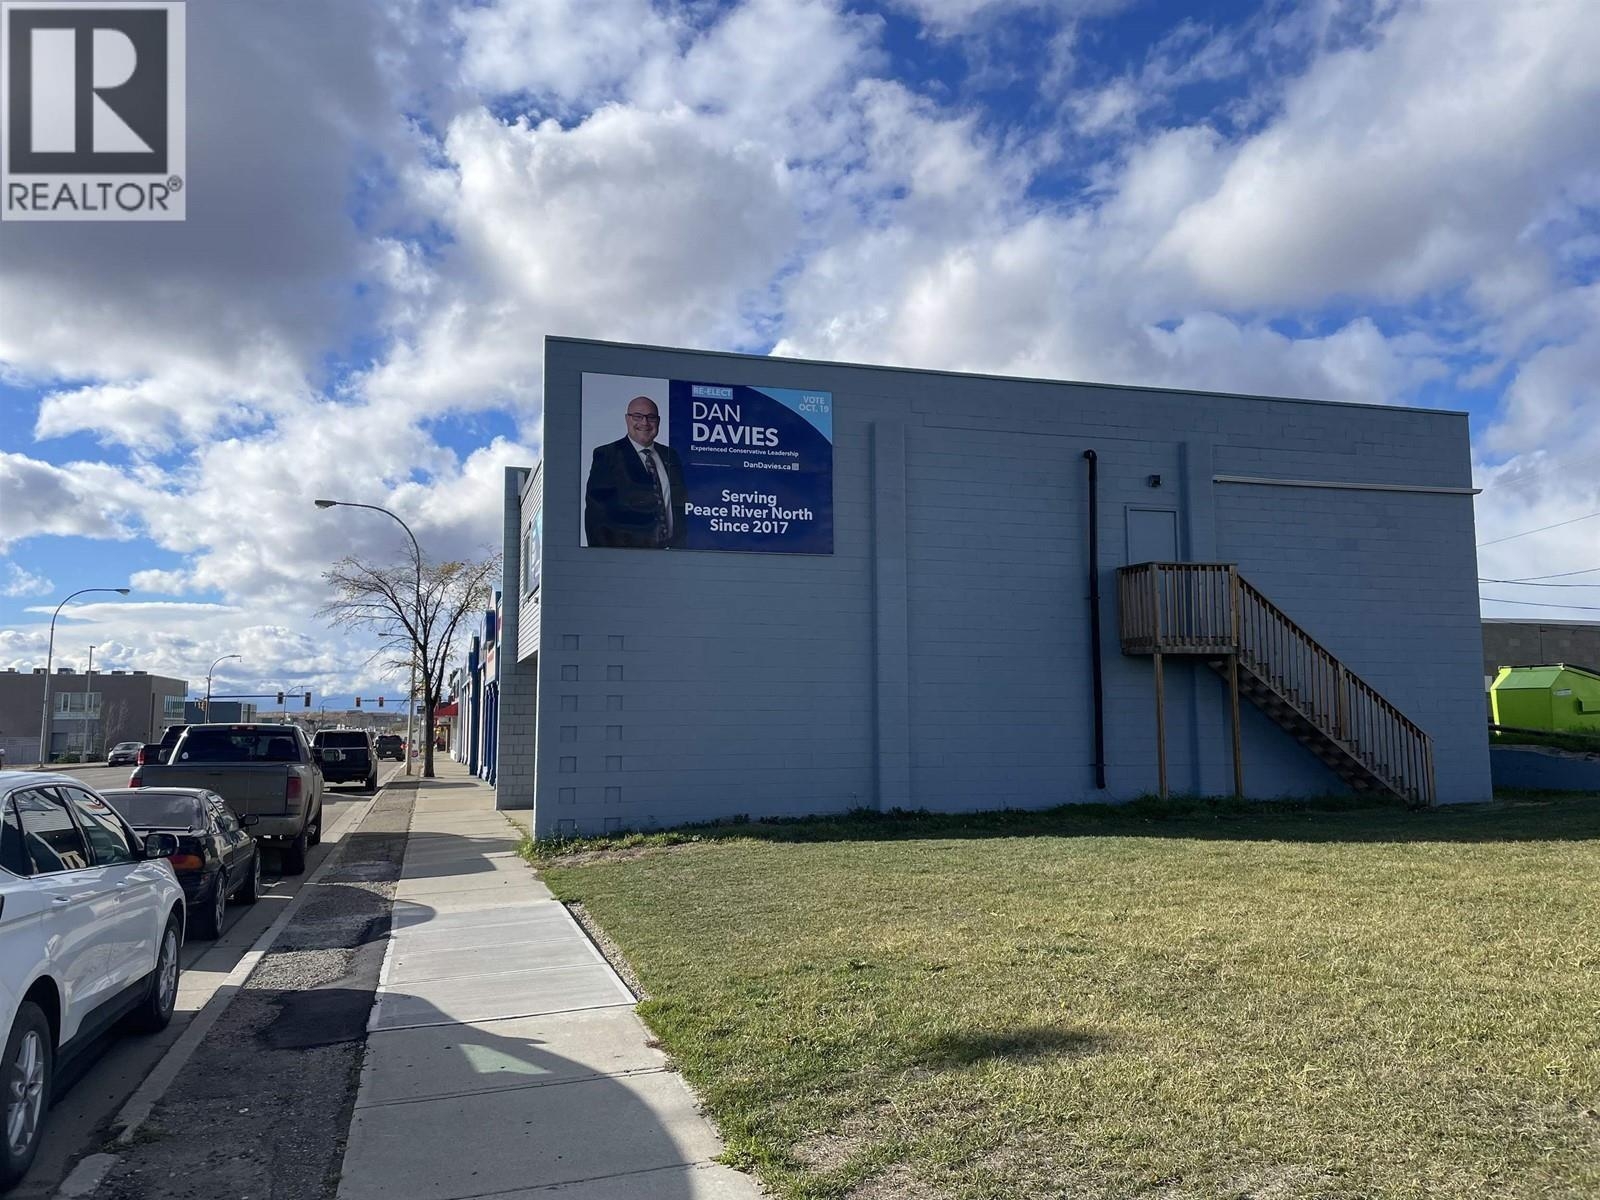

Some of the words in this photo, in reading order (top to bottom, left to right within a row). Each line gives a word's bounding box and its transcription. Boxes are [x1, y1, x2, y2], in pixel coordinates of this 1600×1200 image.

[692, 386, 732, 397] RE-ELECT
[803, 395, 825, 405] VOTE
[692, 401, 741, 423] DAN
[799, 404, 818, 413] OCT.
[820, 405, 830, 413] 19
[692, 422, 779, 447] DAVIES
[690, 444, 728, 453] Experienced
[728, 447, 766, 455] Conservative
[768, 449, 799, 458] Leadership
[743, 461, 791, 471] DanDavies.ca
[722, 489, 777, 507] Serving
[684, 502, 728, 517] Peace
[732, 505, 768, 519] River
[772, 507, 813, 520] North
[710, 518, 750, 533] Since
[752, 520, 789, 534] 2017
